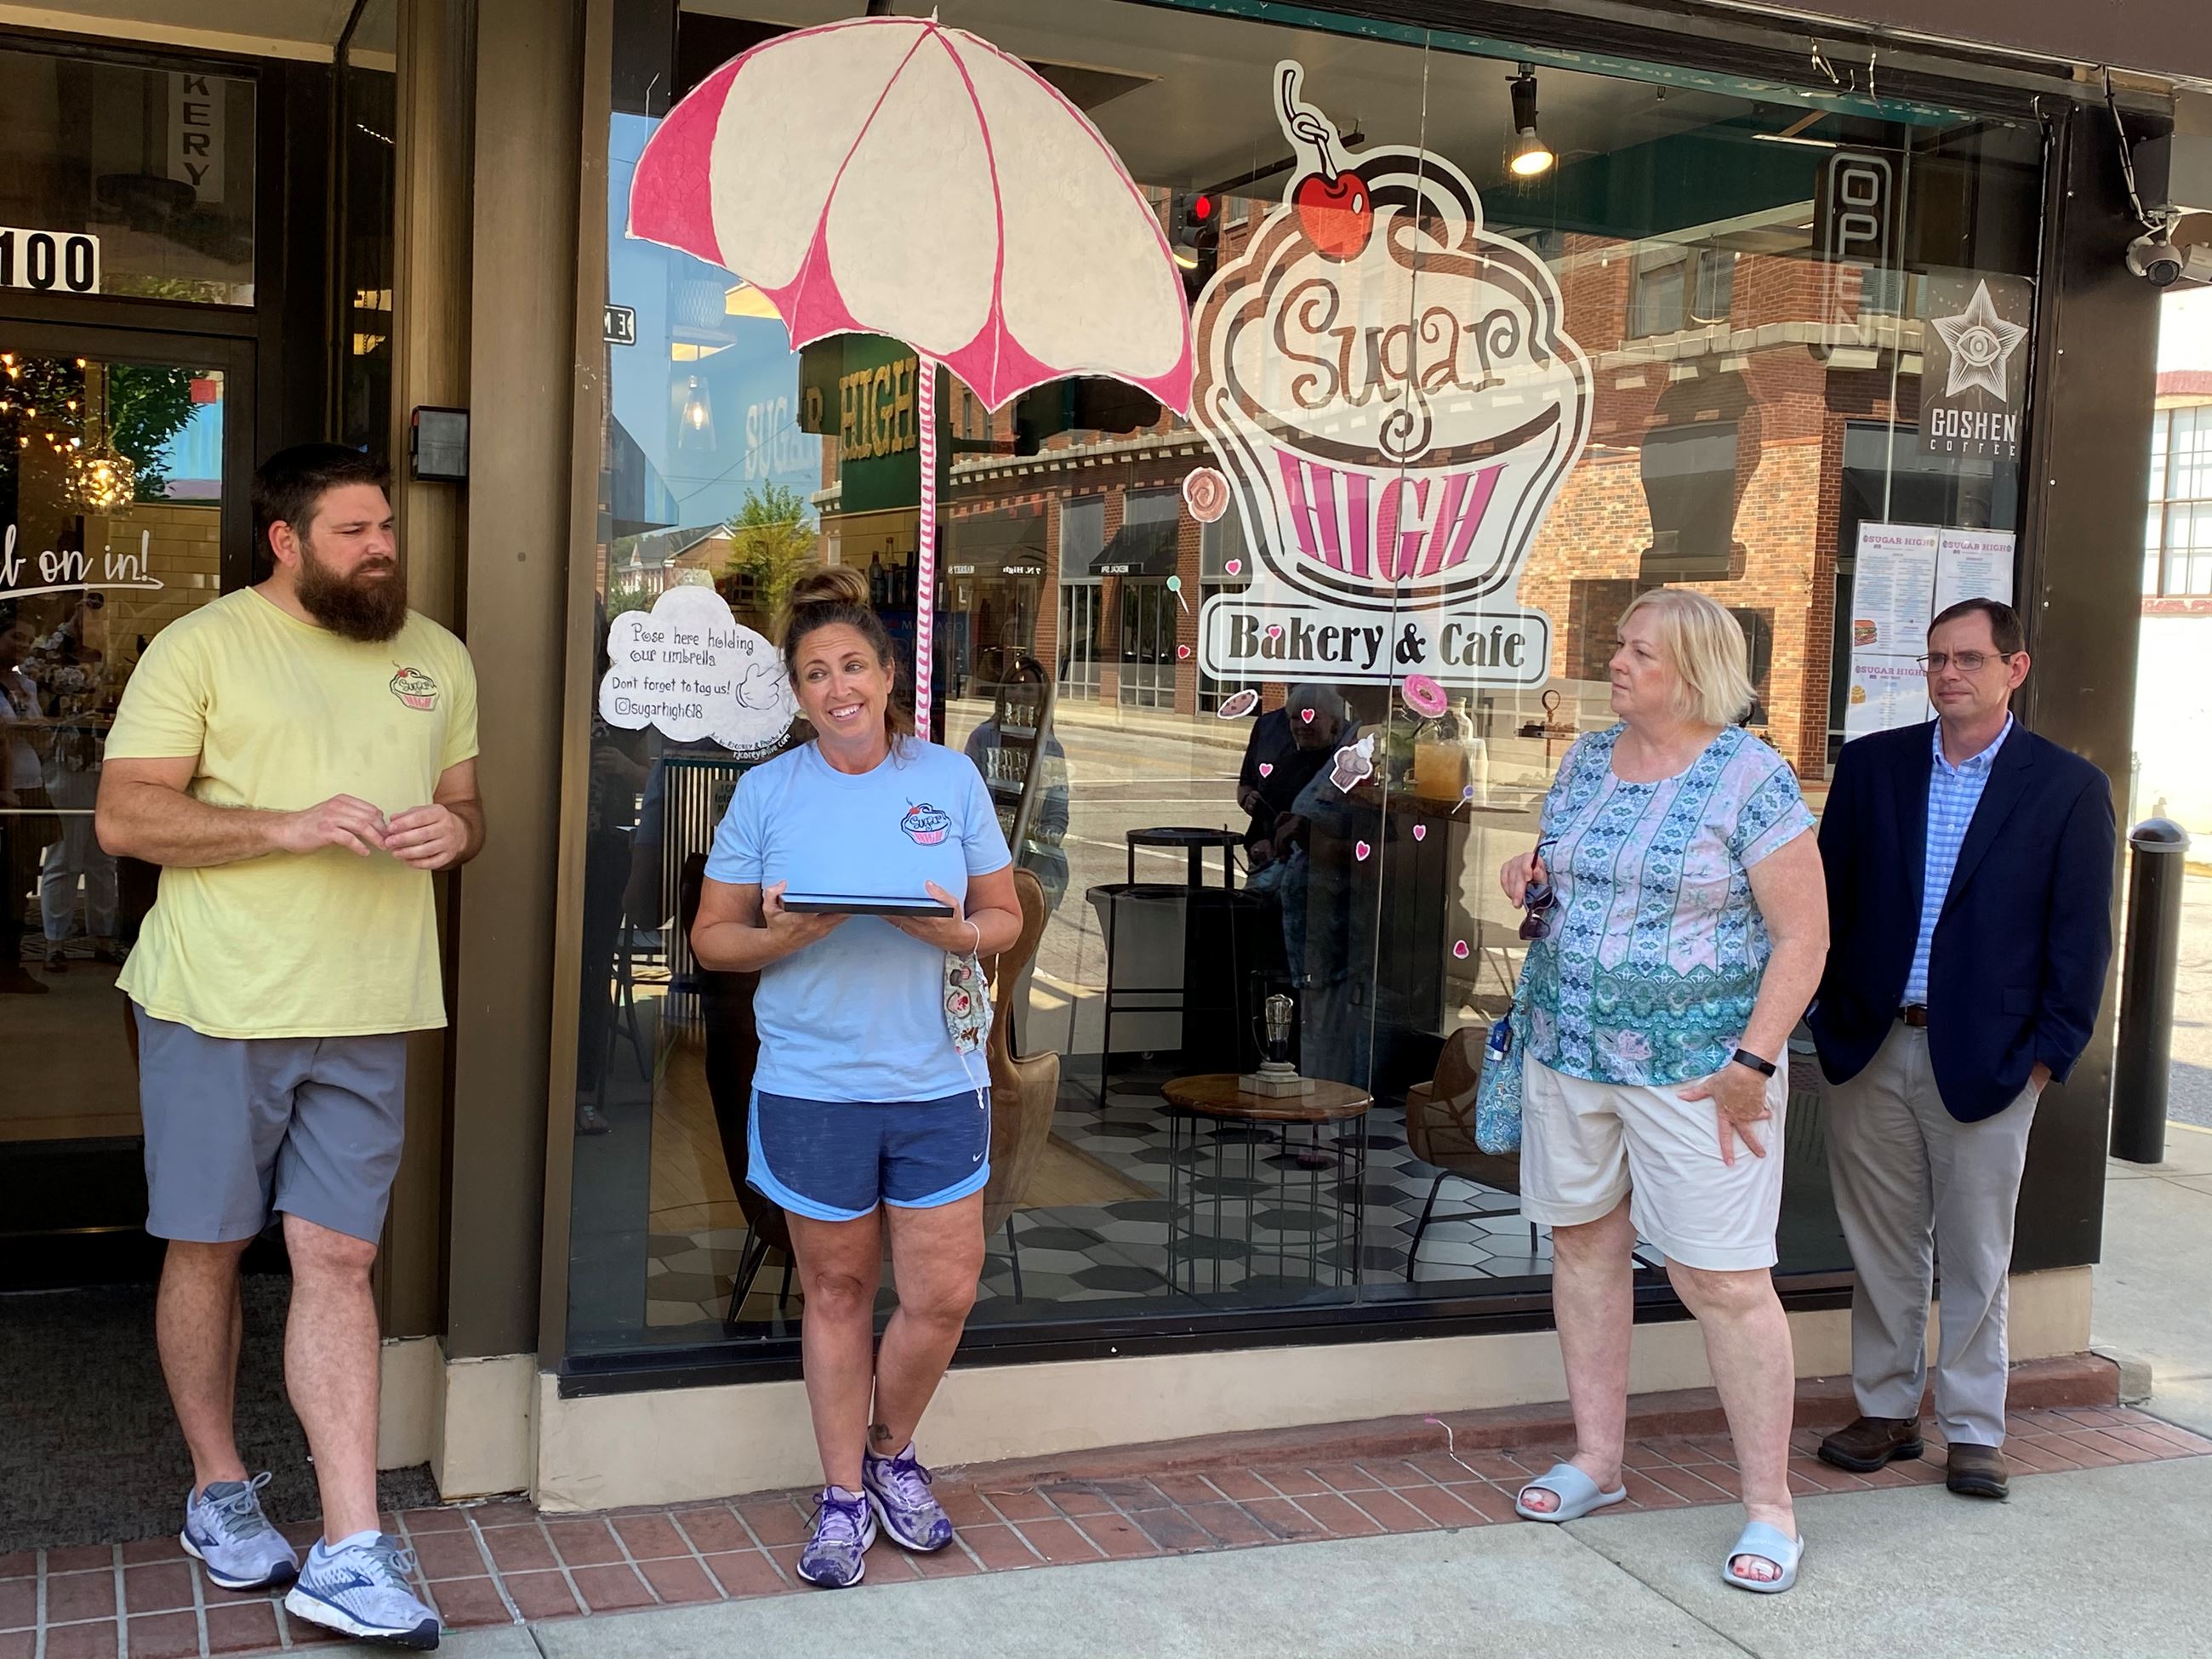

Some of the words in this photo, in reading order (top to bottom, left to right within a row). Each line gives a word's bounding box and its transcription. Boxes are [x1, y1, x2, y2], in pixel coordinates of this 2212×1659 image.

[0, 231, 94, 291] 100
[1837, 169, 1878, 346] OPEN
[1274, 278, 1520, 458] Sugar
[838, 355, 919, 461] HIGH
[1931, 408, 2017, 442] GOSHEN
[1930, 439, 2016, 457] COFFEE
[1270, 444, 1509, 584] HIGH
[39, 550, 94, 583] on
[105, 529, 150, 582] in!
[1867, 535, 1902, 544] SUGAR
[1947, 540, 1980, 550] SUGAR
[1981, 544, 2007, 552] HIGH
[631, 623, 664, 643] Pose
[674, 626, 699, 646] here
[708, 627, 754, 656] holding
[1229, 614, 1384, 670] Bakery
[1395, 622, 1427, 665] &
[1439, 622, 1526, 668] Cafe
[630, 649, 656, 662] our
[663, 649, 716, 666] umbrella
[1861, 666, 1896, 675] SUGAR
[1896, 668, 1923, 676] HIGH
[644, 676, 676, 693] forget
[681, 680, 692, 693] to
[695, 680, 711, 696] tag
[714, 680, 731, 694] us!
[631, 701, 703, 721] sugarhigh618
[909, 815, 942, 831] Sugar
